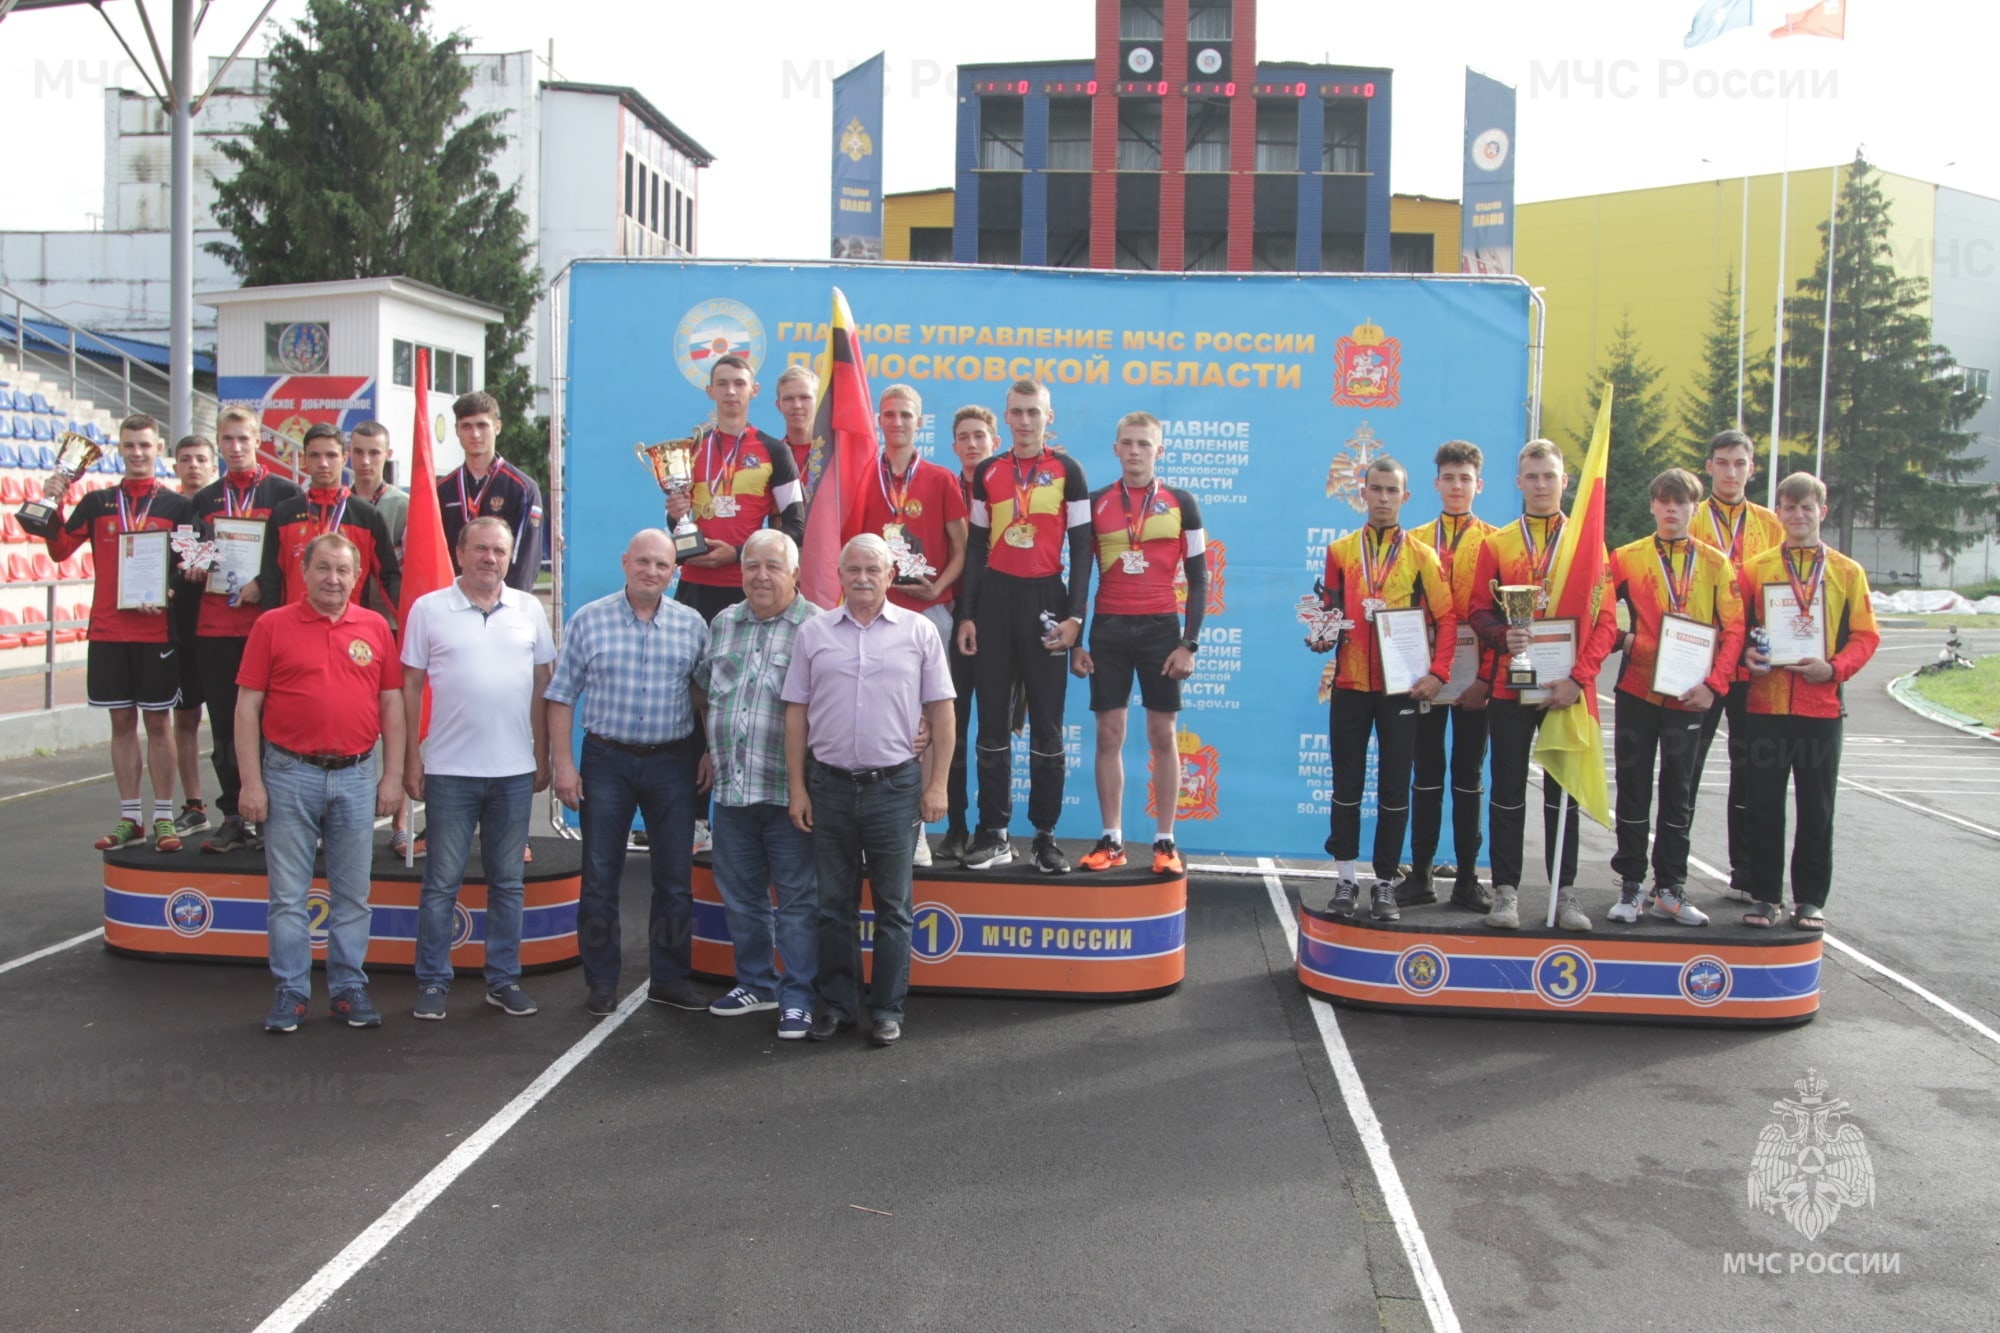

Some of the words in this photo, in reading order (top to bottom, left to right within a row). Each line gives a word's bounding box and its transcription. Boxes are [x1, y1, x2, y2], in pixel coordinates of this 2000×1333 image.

[777, 322, 912, 344] ГЛАНОЕ
[920, 324, 1114, 349] УПРАВЛЕНИЕ
[1122, 330, 1186, 351] МЧС
[1195, 332, 1317, 354] РОССИИ
[1122, 360, 1303, 389] ОБЛАСТИ
[1160, 420, 1250, 438] ЛАВНОЕ
[1164, 438, 1249, 452] РАВЛЕНИЕ
[1158, 452, 1177, 464] ЧС
[1182, 452, 1249, 467] РОССИИ
[1678, 632, 1709, 647] ГРАМОТА
[1196, 659, 1241, 672] ССИИ
[1182, 683, 1225, 695] АСТИ
[1298, 765, 1333, 778] МЧС
[307, 898, 330, 937] 2
[919, 912, 939, 953] 1
[982, 925, 1033, 948] МЧС
[1042, 927, 1133, 951] РОССИИ
[1549, 954, 1578, 997] 3
